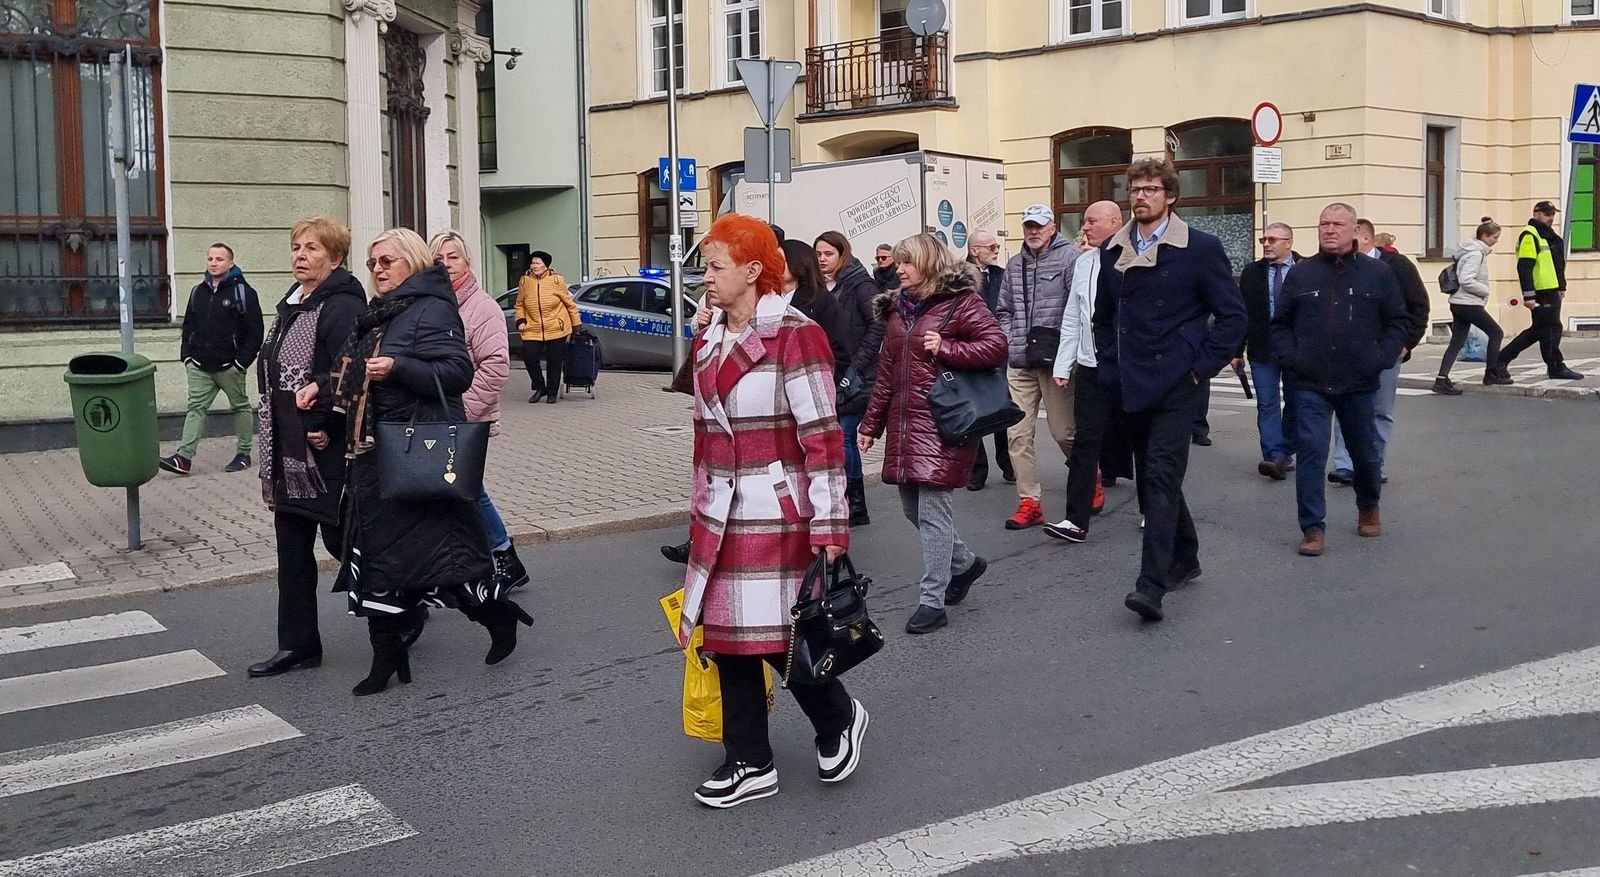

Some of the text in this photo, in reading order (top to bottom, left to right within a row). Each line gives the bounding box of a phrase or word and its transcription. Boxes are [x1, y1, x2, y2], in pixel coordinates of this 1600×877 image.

[1335, 146, 1342, 154] 12
[846, 185, 901, 218] DOWOZIMY CZĘŚCI
[853, 195, 902, 224] MERCEDES-BENZ
[848, 199, 912, 238] DO TWOJEGO SERWISU
[652, 323, 672, 334] POLIC
